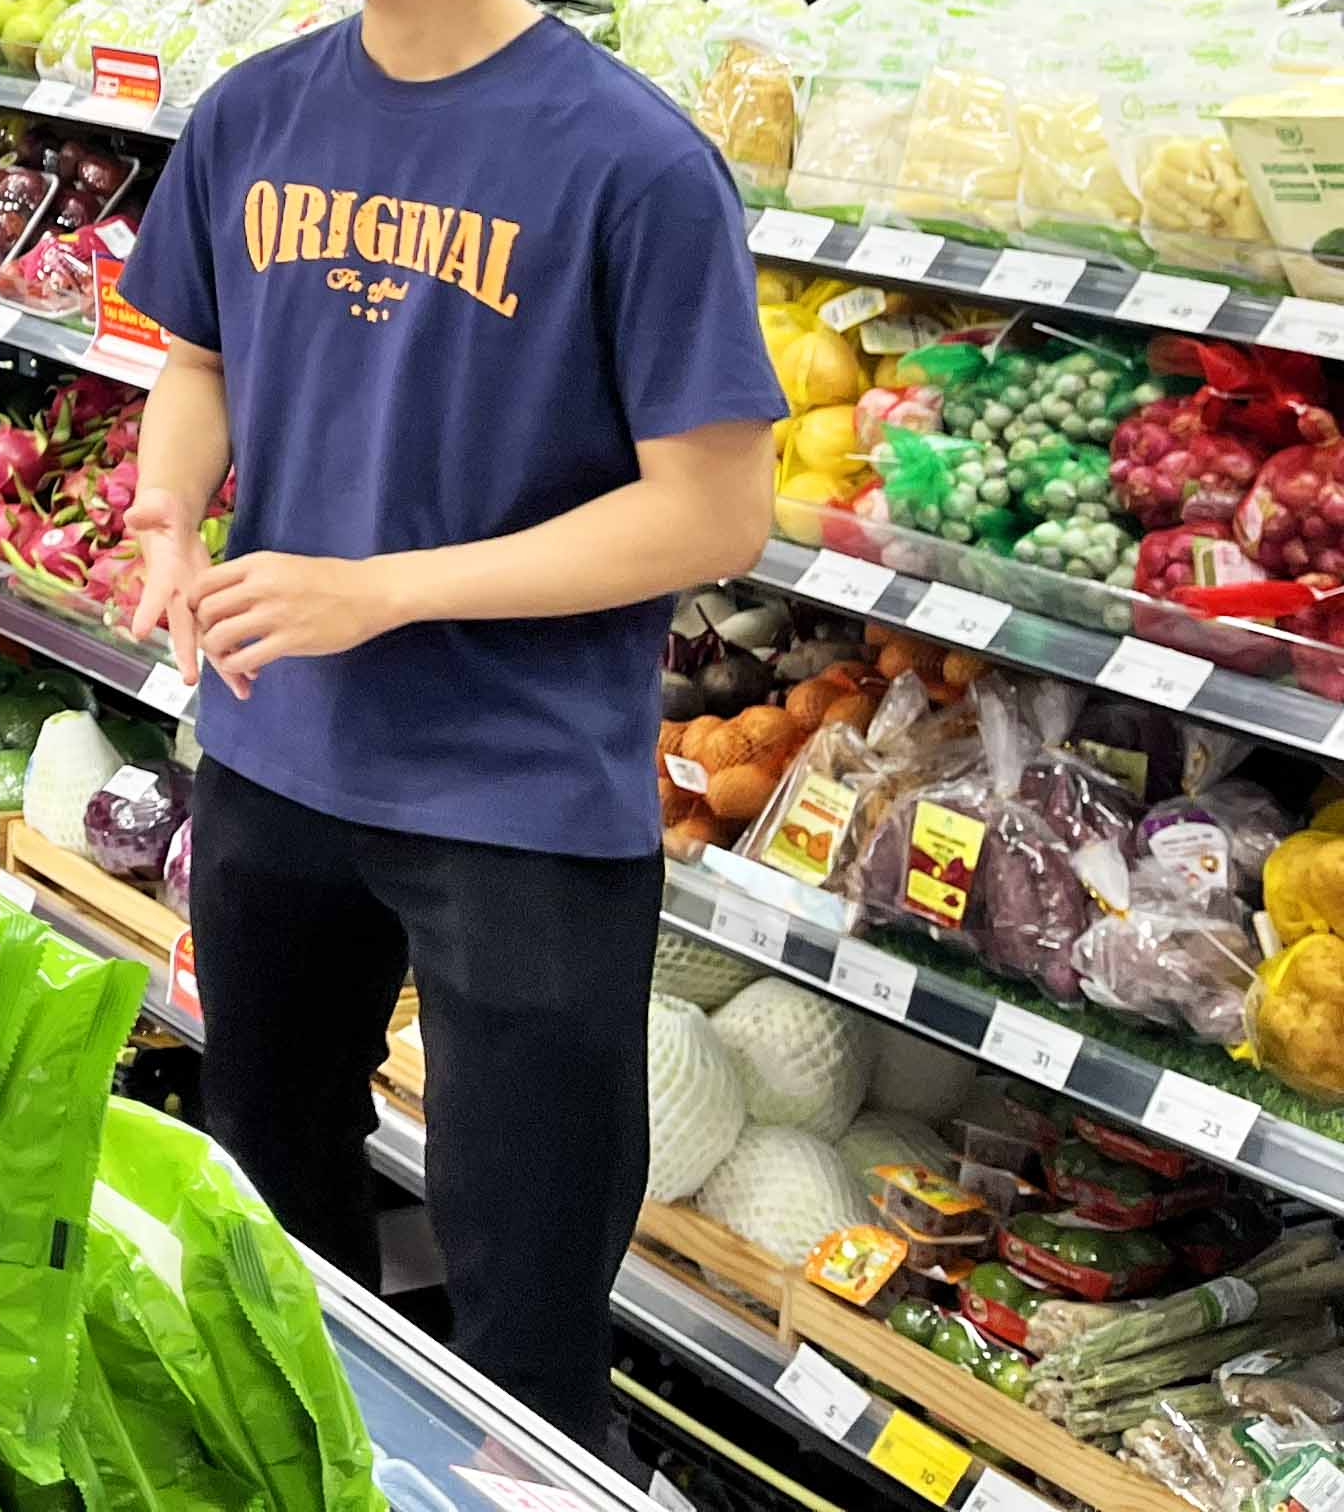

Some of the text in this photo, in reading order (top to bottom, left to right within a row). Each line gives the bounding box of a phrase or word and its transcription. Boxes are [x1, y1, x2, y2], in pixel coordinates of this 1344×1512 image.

[244, 179, 521, 319] ORIGINAL
[750, 930, 768, 947] 32
[873, 982, 891, 1001] 52
[1032, 1050, 1051, 1068] 31
[1199, 1119, 1222, 1139] 23
[824, 1404, 836, 1421] 5
[920, 1468, 936, 1486] 10
